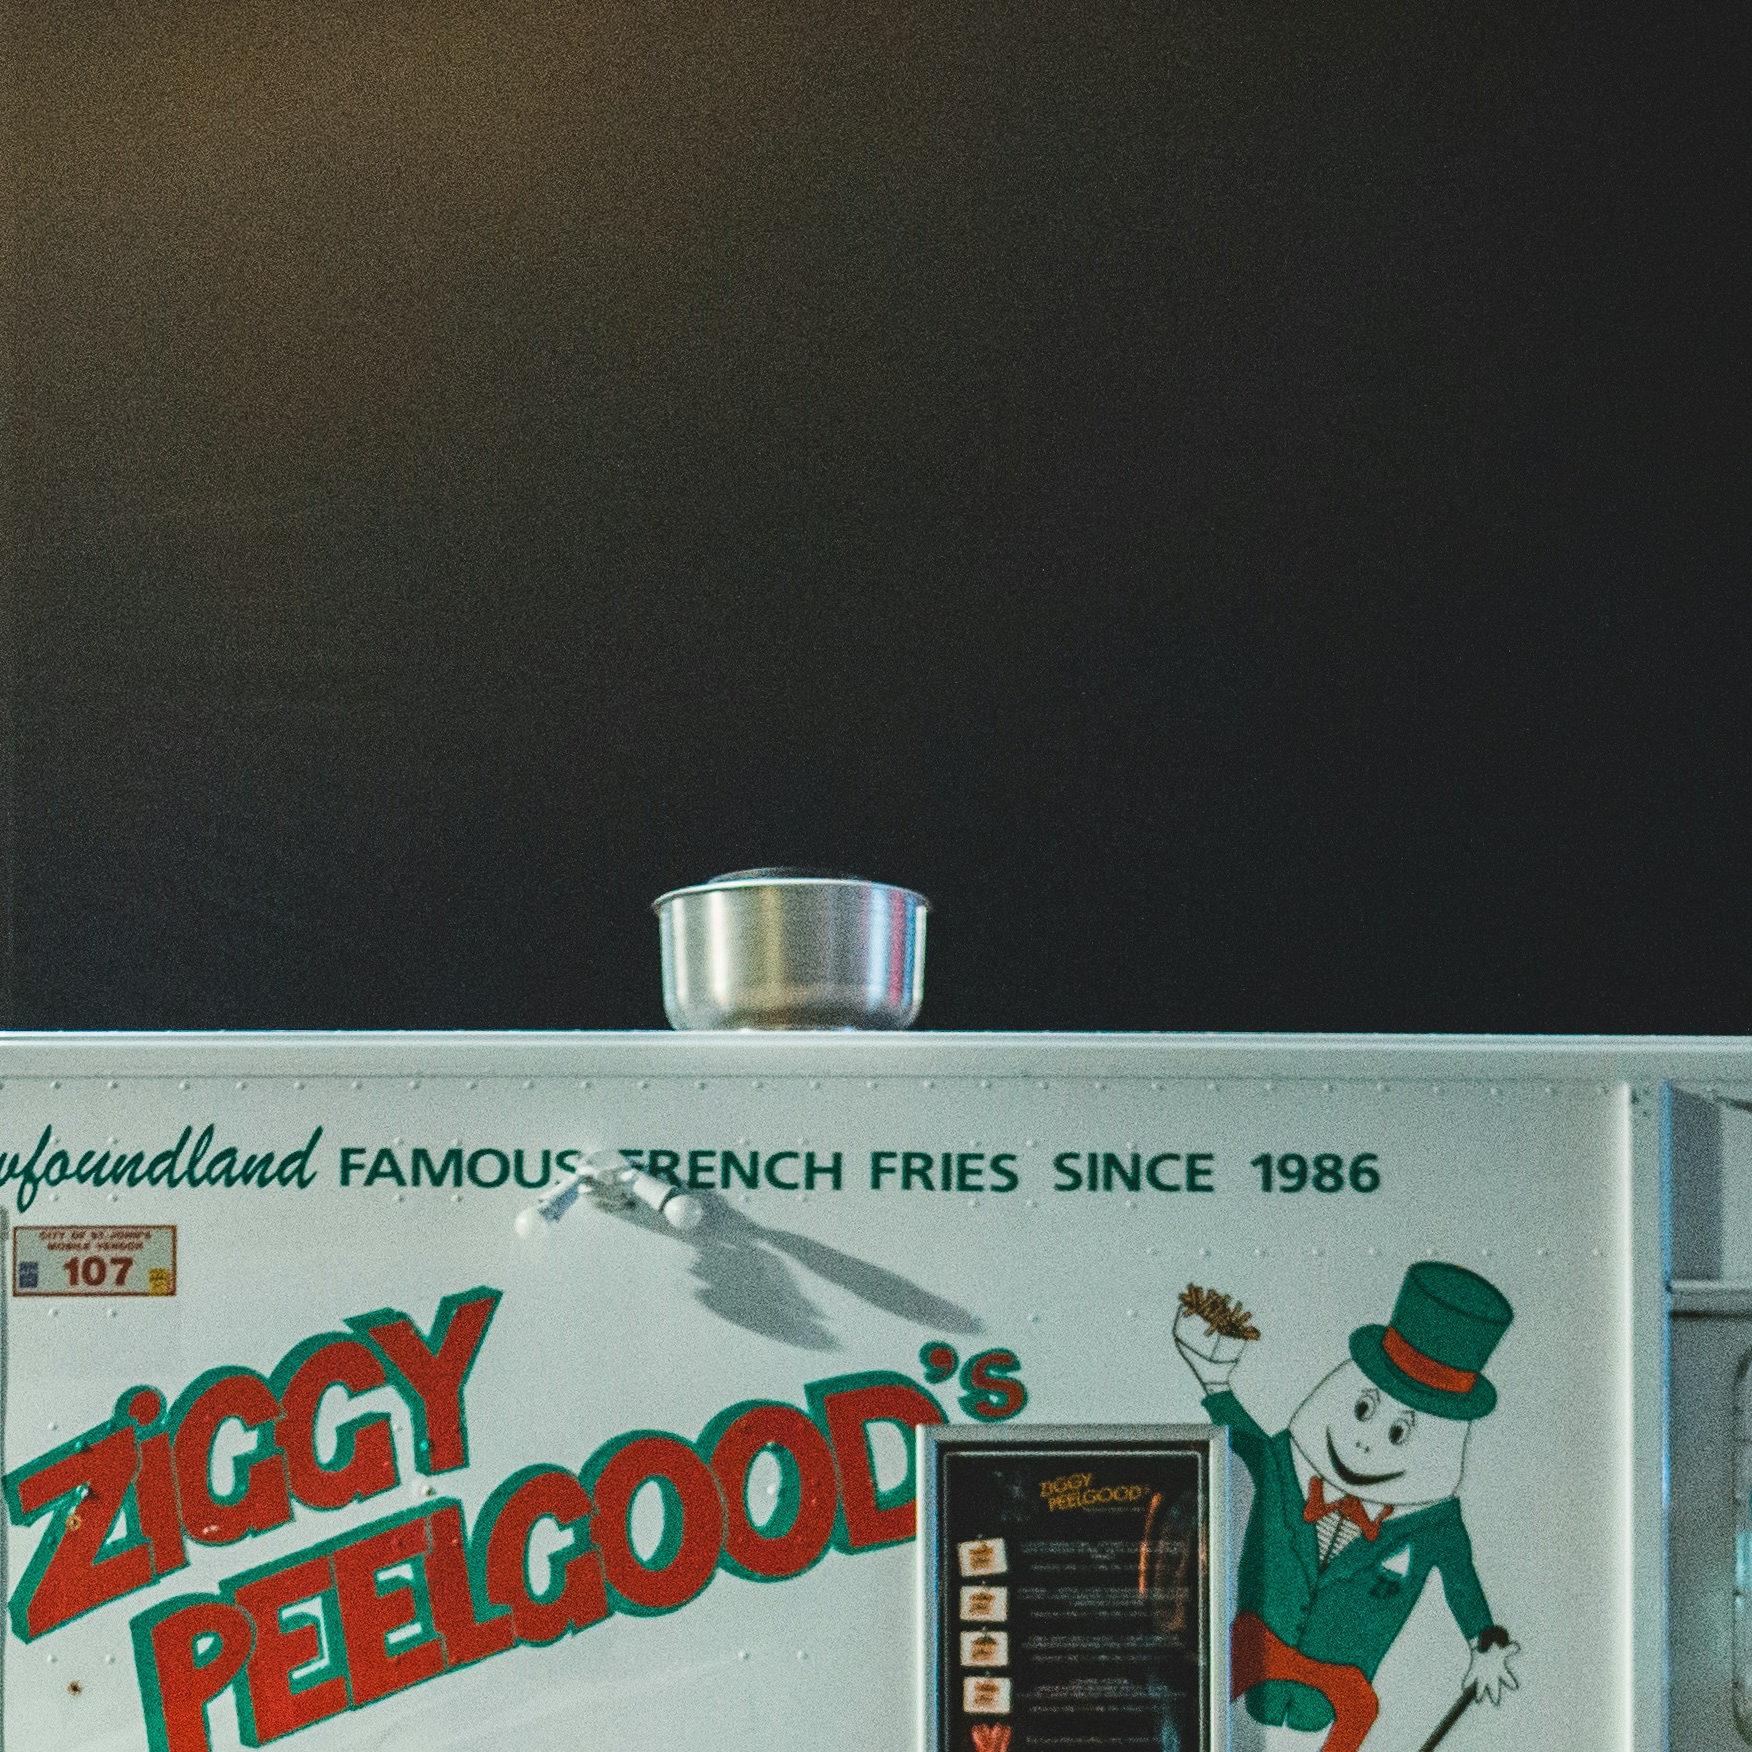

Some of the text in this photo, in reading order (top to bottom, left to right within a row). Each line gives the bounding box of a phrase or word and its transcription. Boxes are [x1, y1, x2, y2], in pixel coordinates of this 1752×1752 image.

[871, 1151, 1020, 1194] FRIES
[1053, 1152, 1215, 1194] SINCE
[1250, 1153, 1383, 1195] 1986
[63, 1255, 135, 1287] 107
